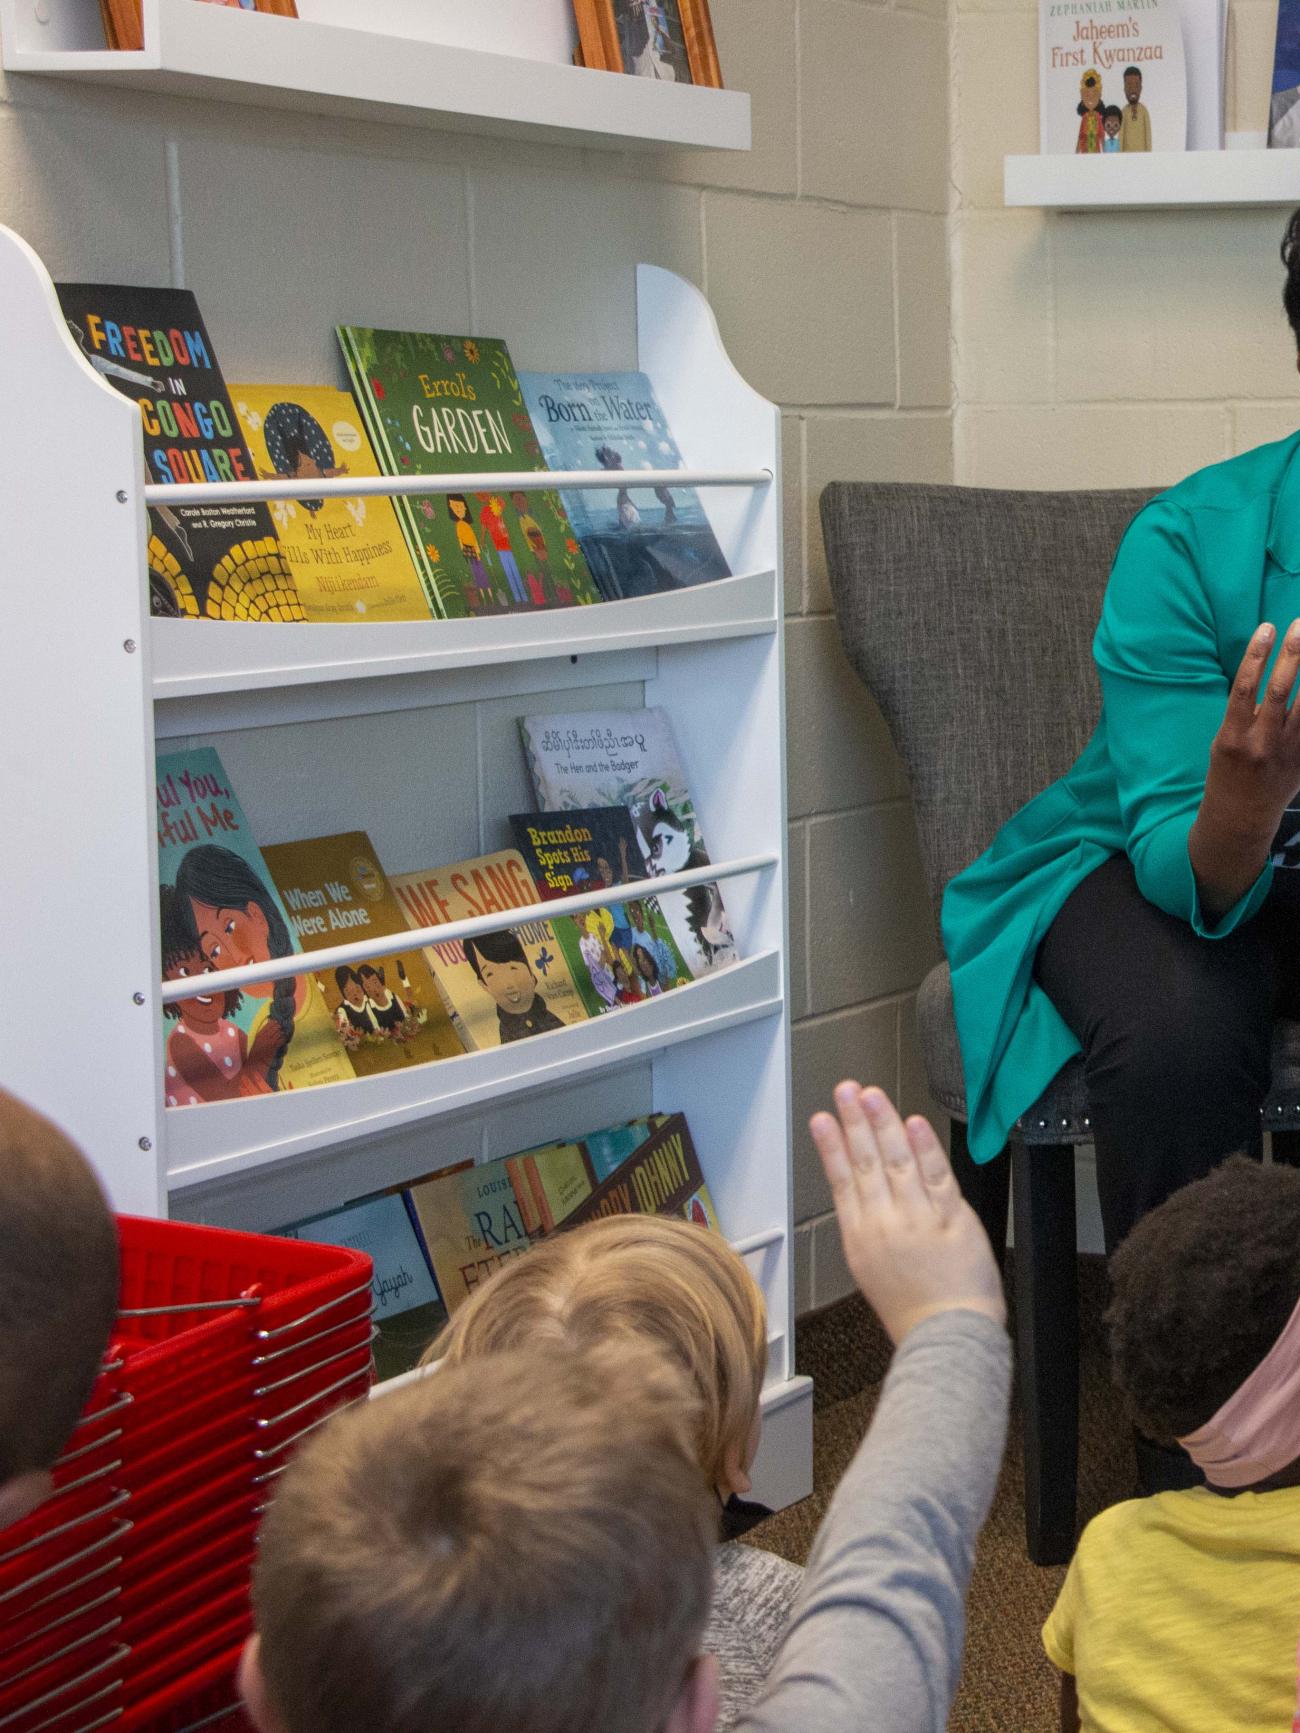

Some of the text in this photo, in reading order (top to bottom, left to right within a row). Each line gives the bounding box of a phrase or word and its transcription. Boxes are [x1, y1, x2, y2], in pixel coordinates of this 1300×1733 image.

[1073, 17, 1140, 42] Jaheem's
[1052, 42, 1164, 69] First Kwanzaa
[86, 313, 212, 369] FREEDOM
[168, 377, 187, 396] IN
[418, 371, 477, 400] Errol's
[138, 398, 233, 440] CONGO
[539, 394, 592, 423] Born
[600, 394, 653, 422] Water
[412, 404, 512, 455] GARDEN
[153, 447, 250, 484] SQUARE
[305, 523, 355, 545] My Heart
[311, 545, 342, 565] With
[344, 540, 393, 567] Happiness
[555, 760, 639, 775] The Hen and the Badger
[179, 768, 230, 803] You,
[196, 803, 239, 837] Me
[527, 824, 593, 847] Brandon
[535, 845, 591, 869] Spots His
[283, 887, 326, 911] When
[324, 881, 352, 902] We
[450, 859, 536, 918] SANG
[544, 872, 574, 891] Sign
[291, 907, 371, 938] Were Alone
[477, 1177, 512, 1198] LOUIS
[630, 1133, 690, 1213] JOHNNY
